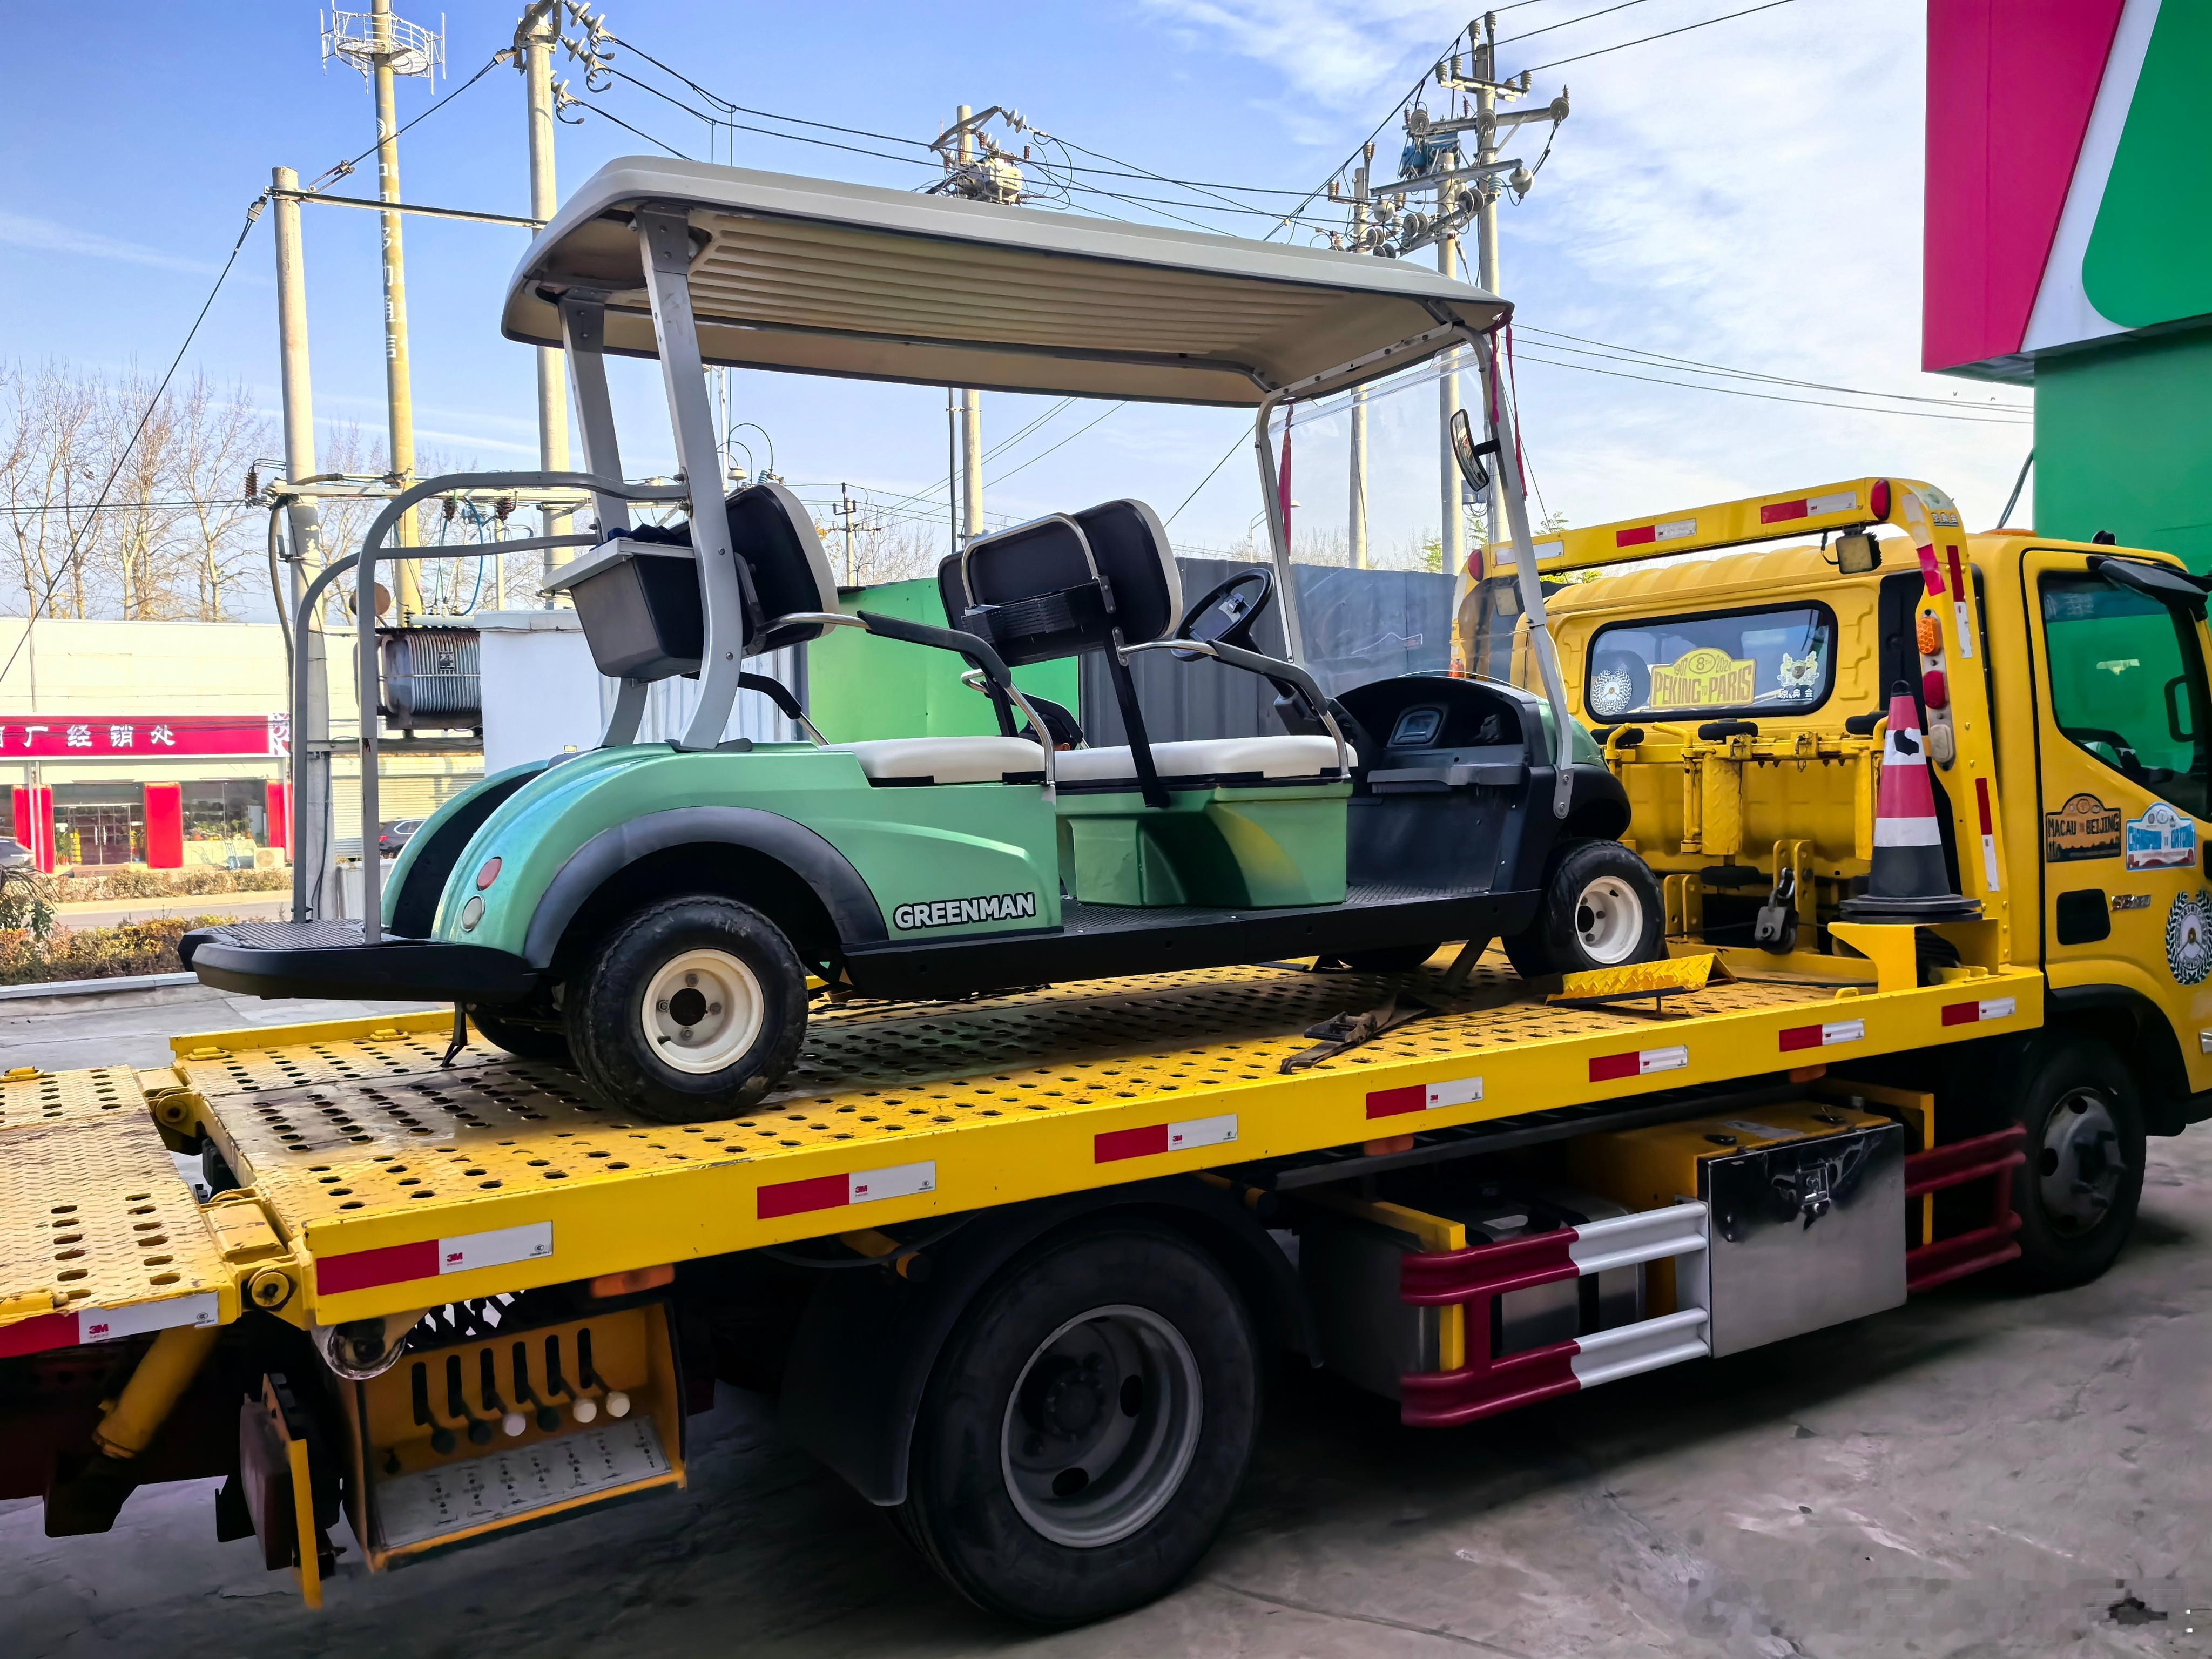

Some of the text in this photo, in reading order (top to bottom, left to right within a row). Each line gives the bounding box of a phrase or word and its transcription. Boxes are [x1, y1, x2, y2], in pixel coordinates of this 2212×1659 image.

[1653, 671, 1702, 706] PEKING
[1702, 685, 1708, 696] TO
[1708, 664, 1752, 703] PARIS
[2048, 817, 2077, 837] MACAU
[2086, 813, 2120, 834] BEIJING
[894, 893, 1036, 930] GREENMAN
[855, 1185, 868, 1193] 3M
[447, 1252, 463, 1262] 3M
[89, 1324, 109, 1334] 3M
